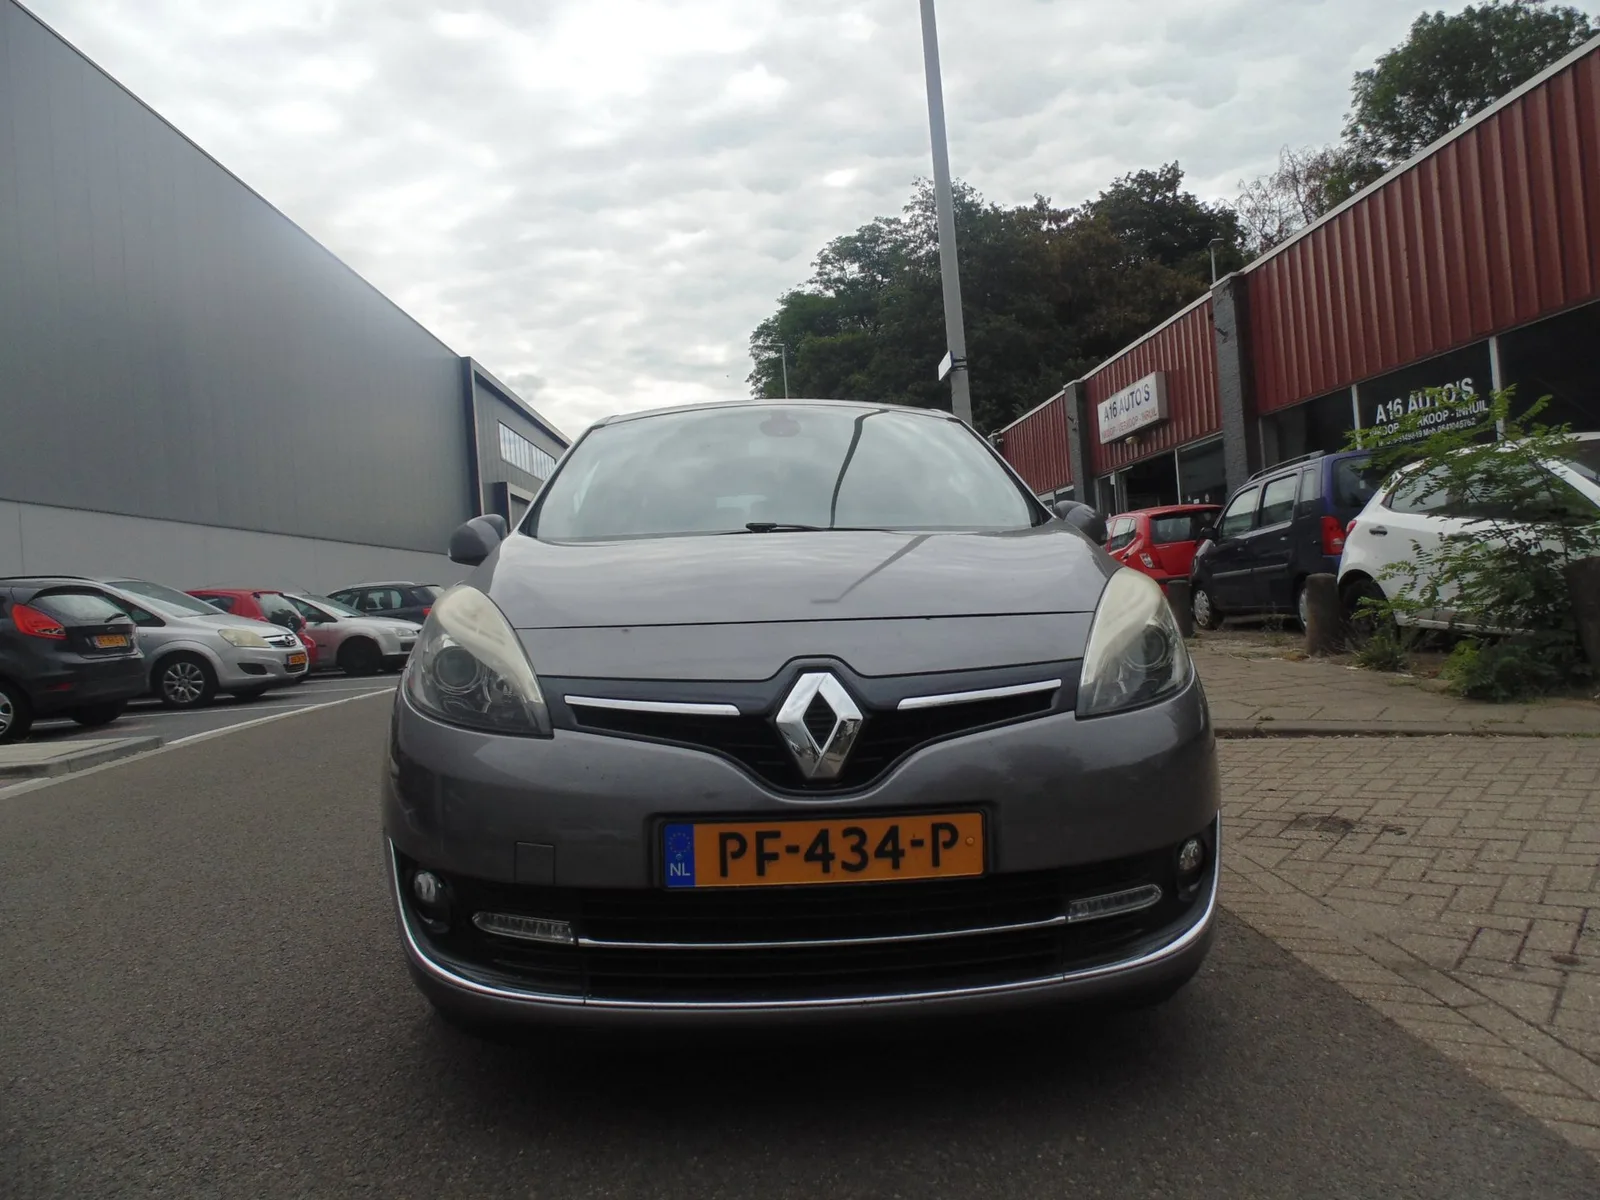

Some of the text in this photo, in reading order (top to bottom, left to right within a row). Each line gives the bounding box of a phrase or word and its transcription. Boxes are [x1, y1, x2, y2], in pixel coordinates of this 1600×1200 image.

[1104, 384, 1151, 422] A16 AUTO'S
[1376, 398, 1403, 424] A16
[718, 822, 959, 878] PF-434-P
[670, 862, 691, 877] NL
